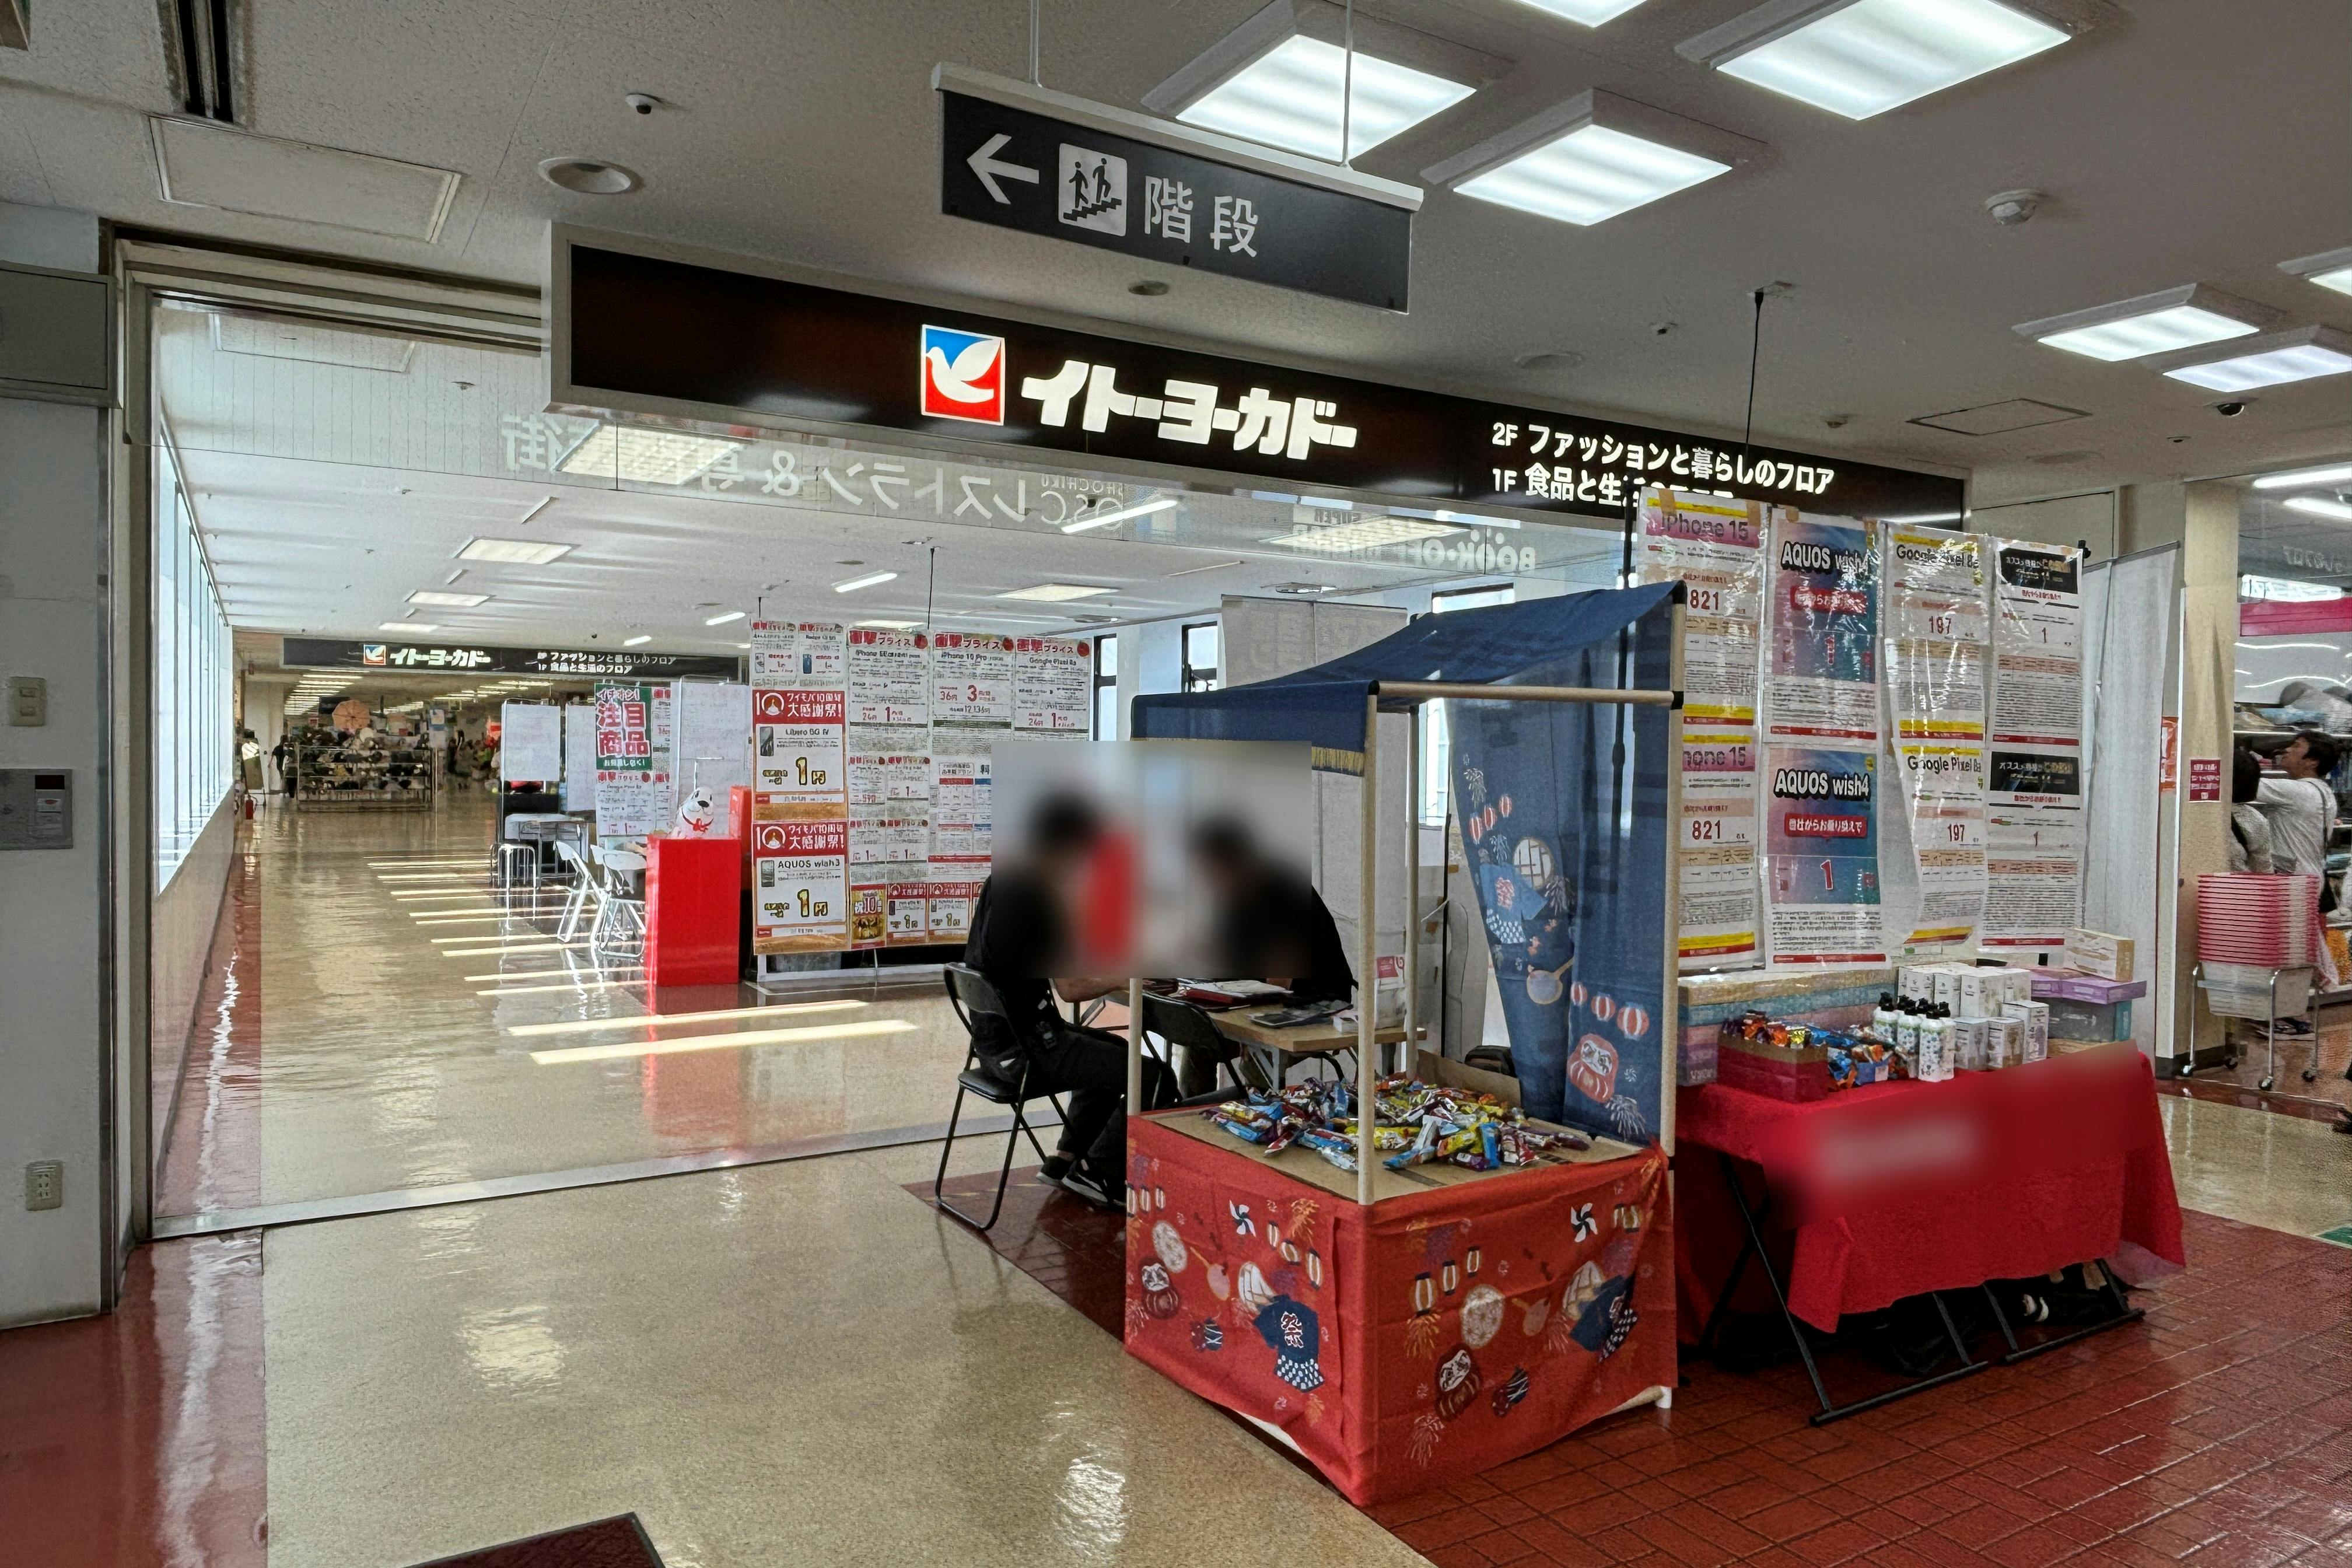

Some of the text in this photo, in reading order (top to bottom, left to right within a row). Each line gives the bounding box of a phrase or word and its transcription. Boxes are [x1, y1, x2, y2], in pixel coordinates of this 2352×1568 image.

[1144, 175, 1258, 258] 階段
[1021, 359, 1357, 460] イトーヨーカドー
[1492, 422, 1835, 495] 2F ファッションと暮らしのフロア
[1492, 468, 1517, 492] 1F
[1728, 519, 1749, 541] 15
[1782, 542, 1832, 570] AQUOS
[1690, 589, 1719, 611] 821
[389, 648, 491, 668] イトーヨーカドー
[967, 684, 978, 702] 3
[596, 701, 647, 730] 注目
[597, 729, 651, 758] 商品
[1728, 746, 1746, 766] 15
[1951, 757, 1972, 772] Pixel
[1774, 769, 1870, 797] AQUOS wish4
[1692, 819, 1721, 840] 821
[1947, 823, 1965, 842] 197
[778, 860, 811, 869] AQUOS
[1820, 859, 1833, 891] 1
